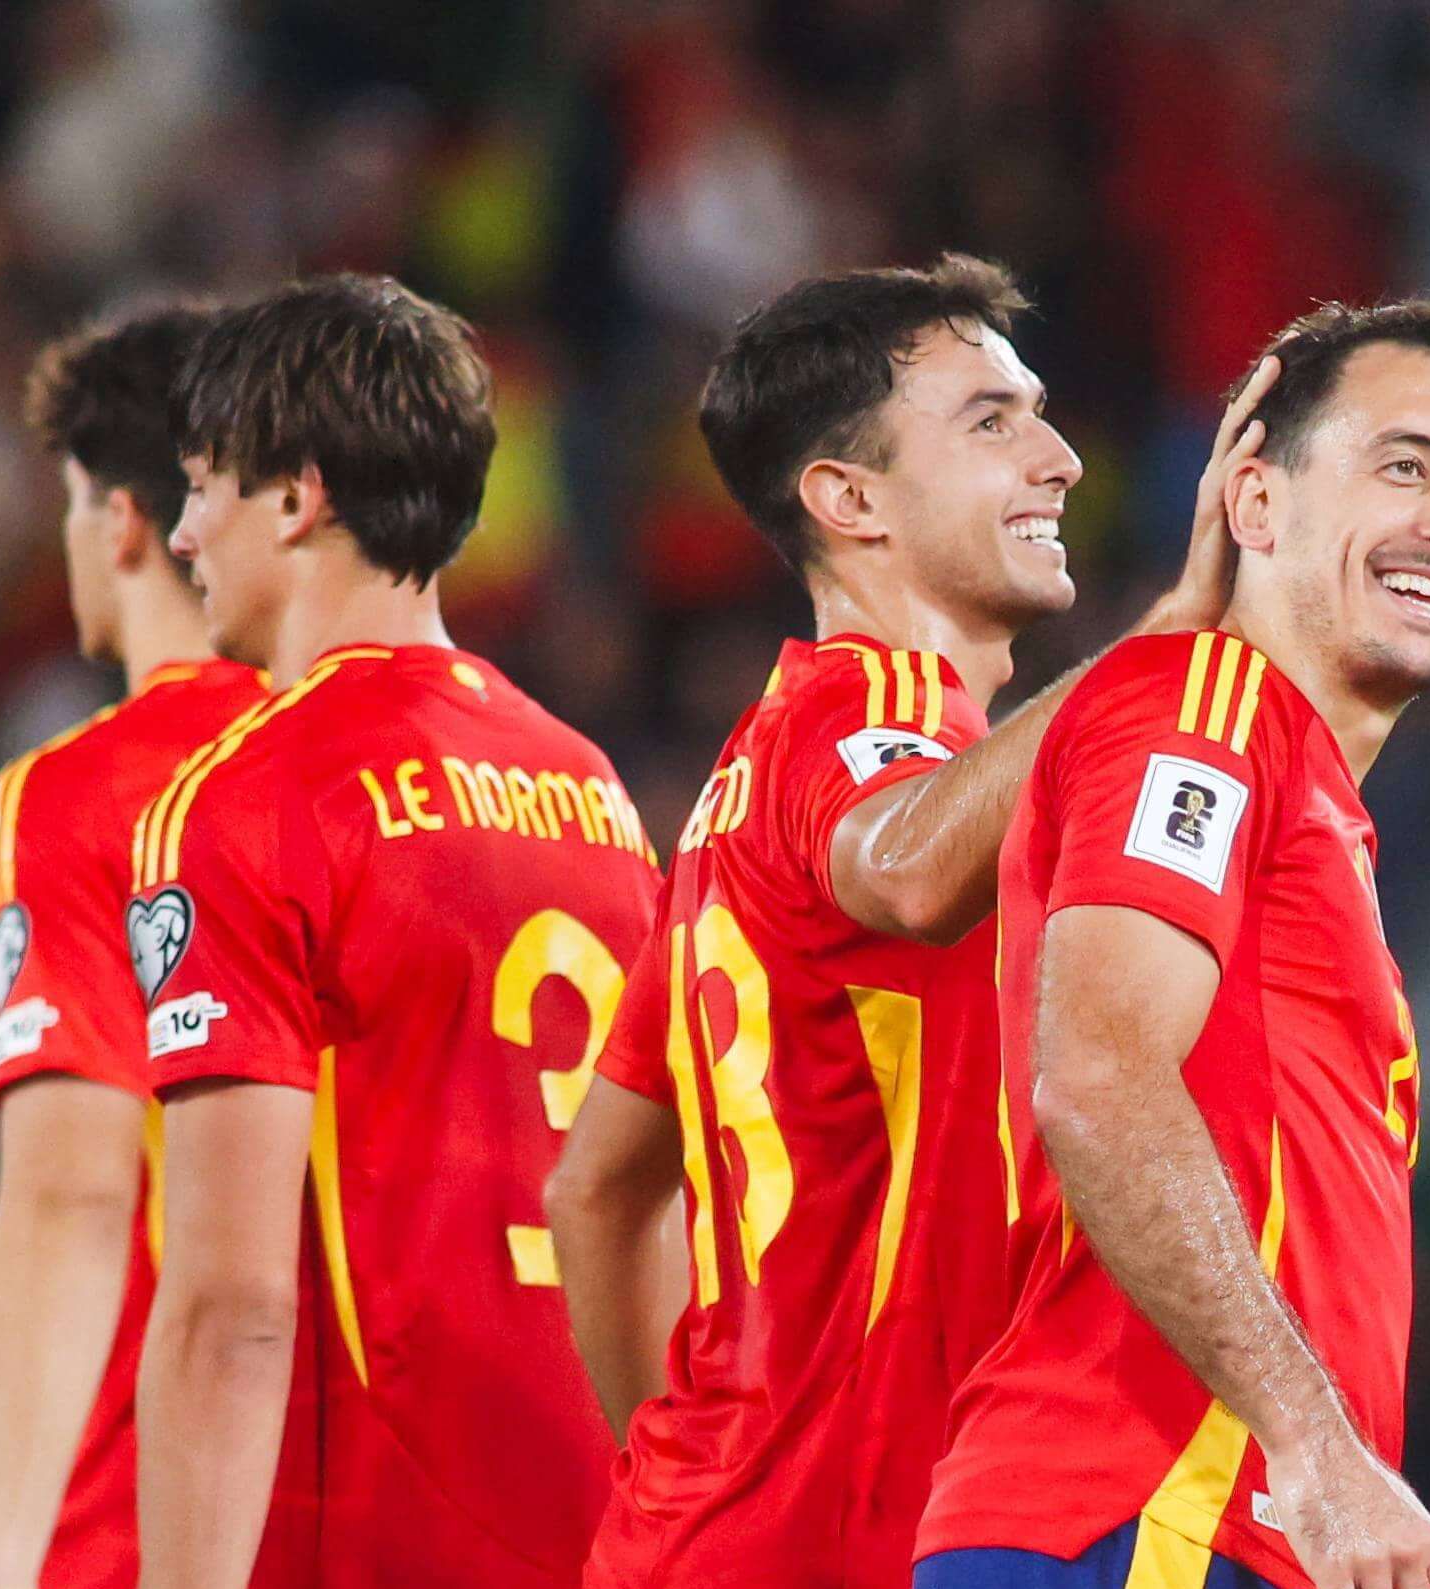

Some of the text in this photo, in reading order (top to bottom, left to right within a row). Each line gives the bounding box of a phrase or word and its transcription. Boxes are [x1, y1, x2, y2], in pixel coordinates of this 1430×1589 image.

[359, 757, 445, 840] LE
[441, 756, 658, 868] NORMAN
[492, 908, 627, 1288] 3
